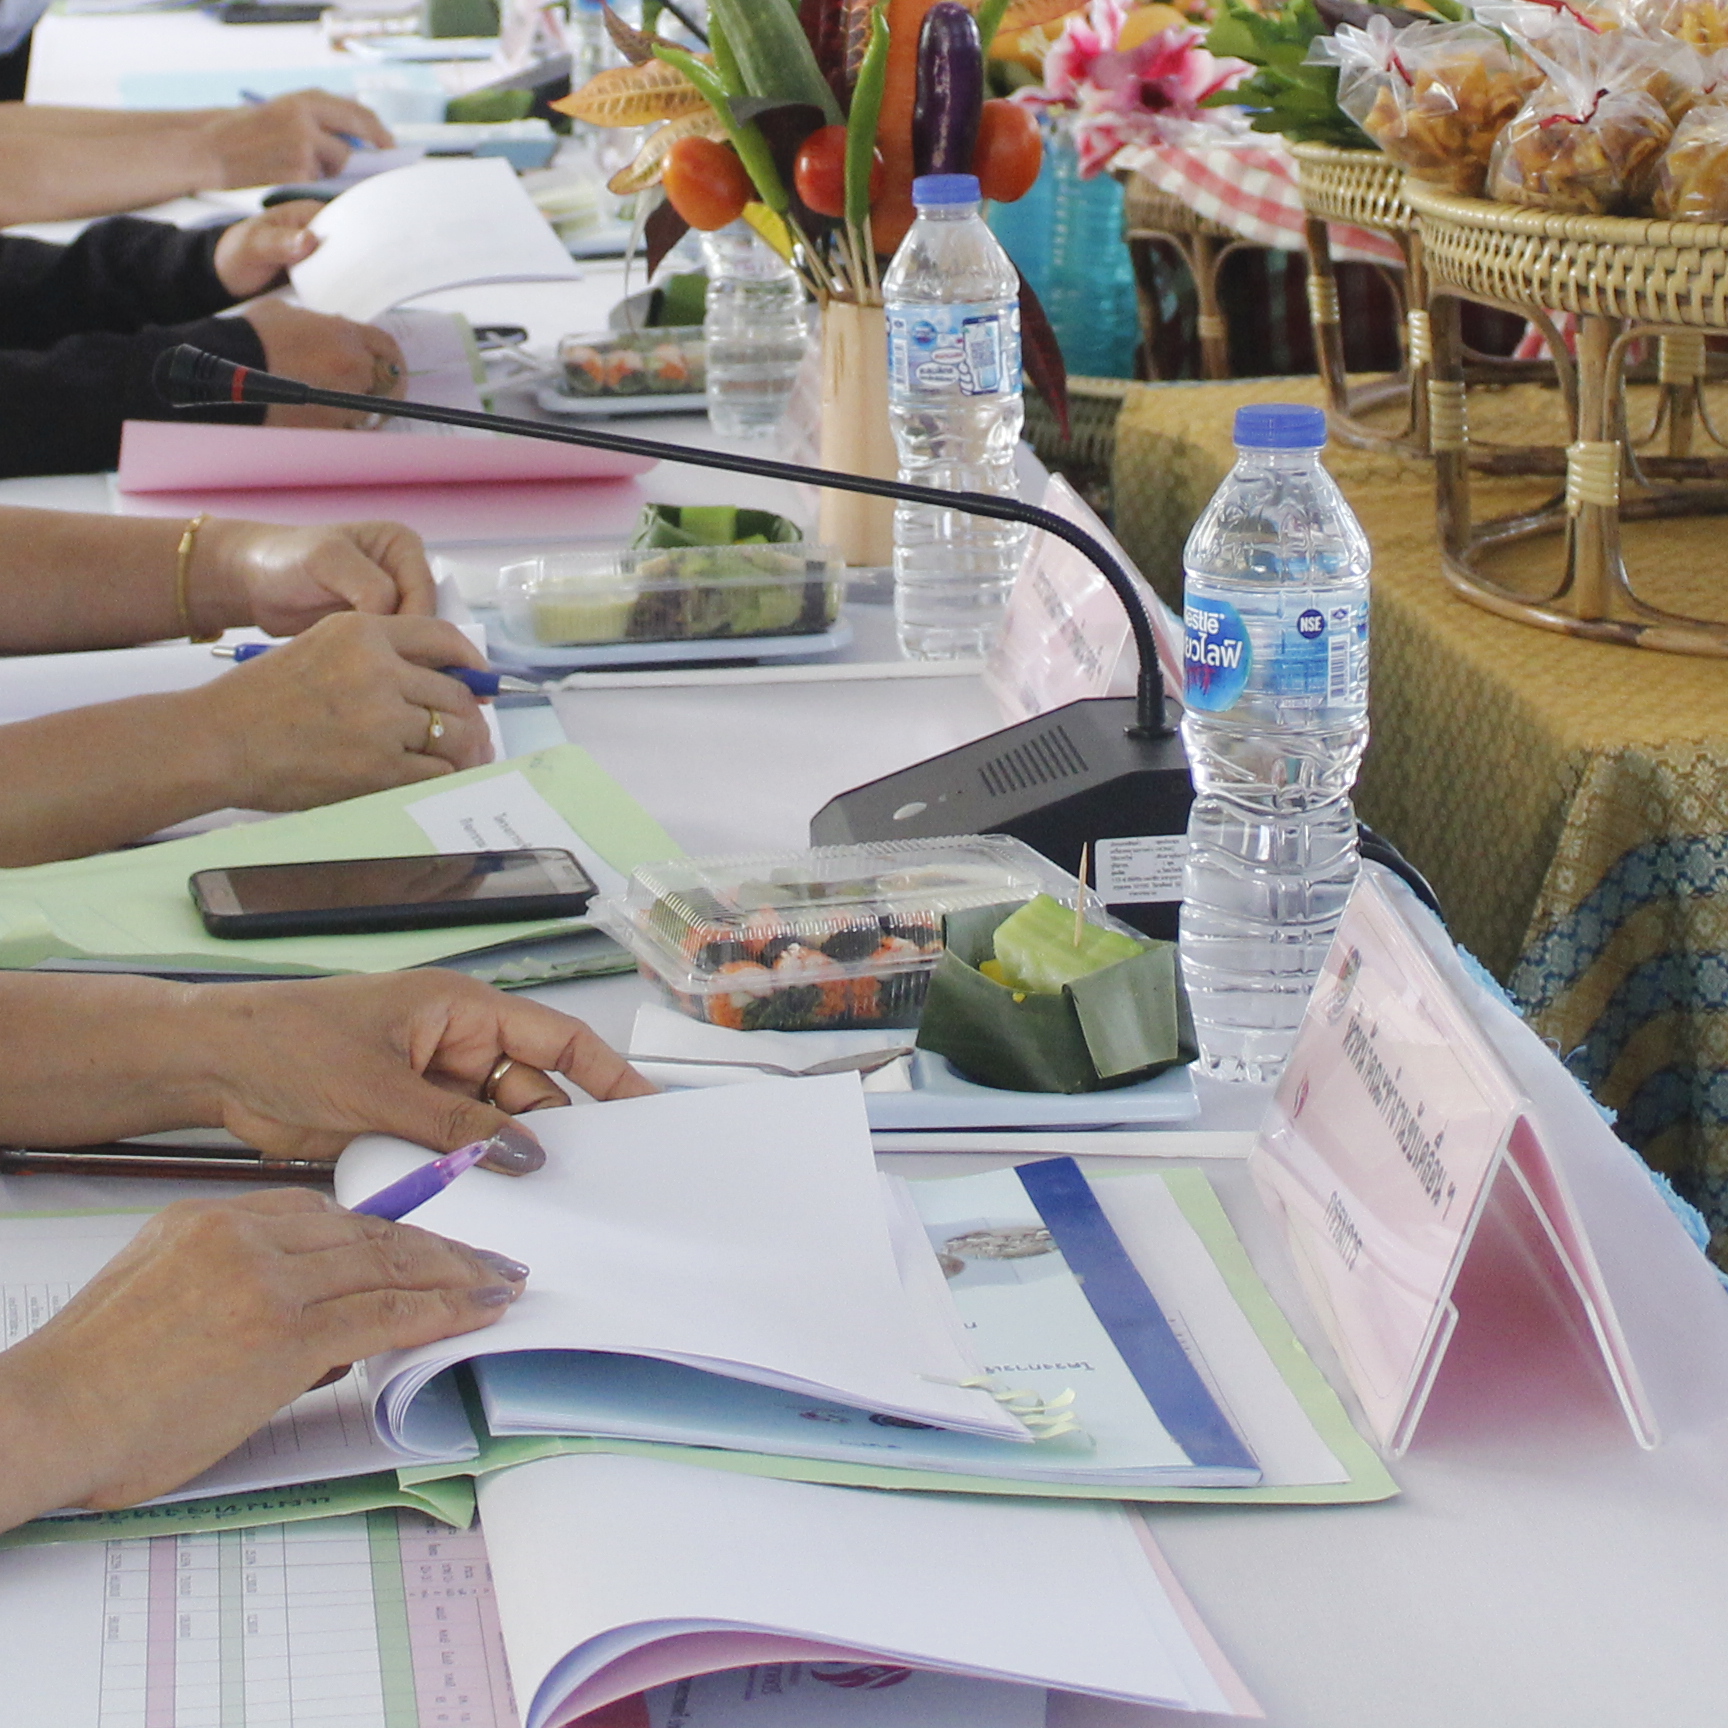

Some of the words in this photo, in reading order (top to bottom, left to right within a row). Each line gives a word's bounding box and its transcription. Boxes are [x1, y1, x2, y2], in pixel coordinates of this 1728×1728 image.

[1185, 605, 1226, 634] estlé
[1325, 1189, 1363, 1272] กรรมการ
